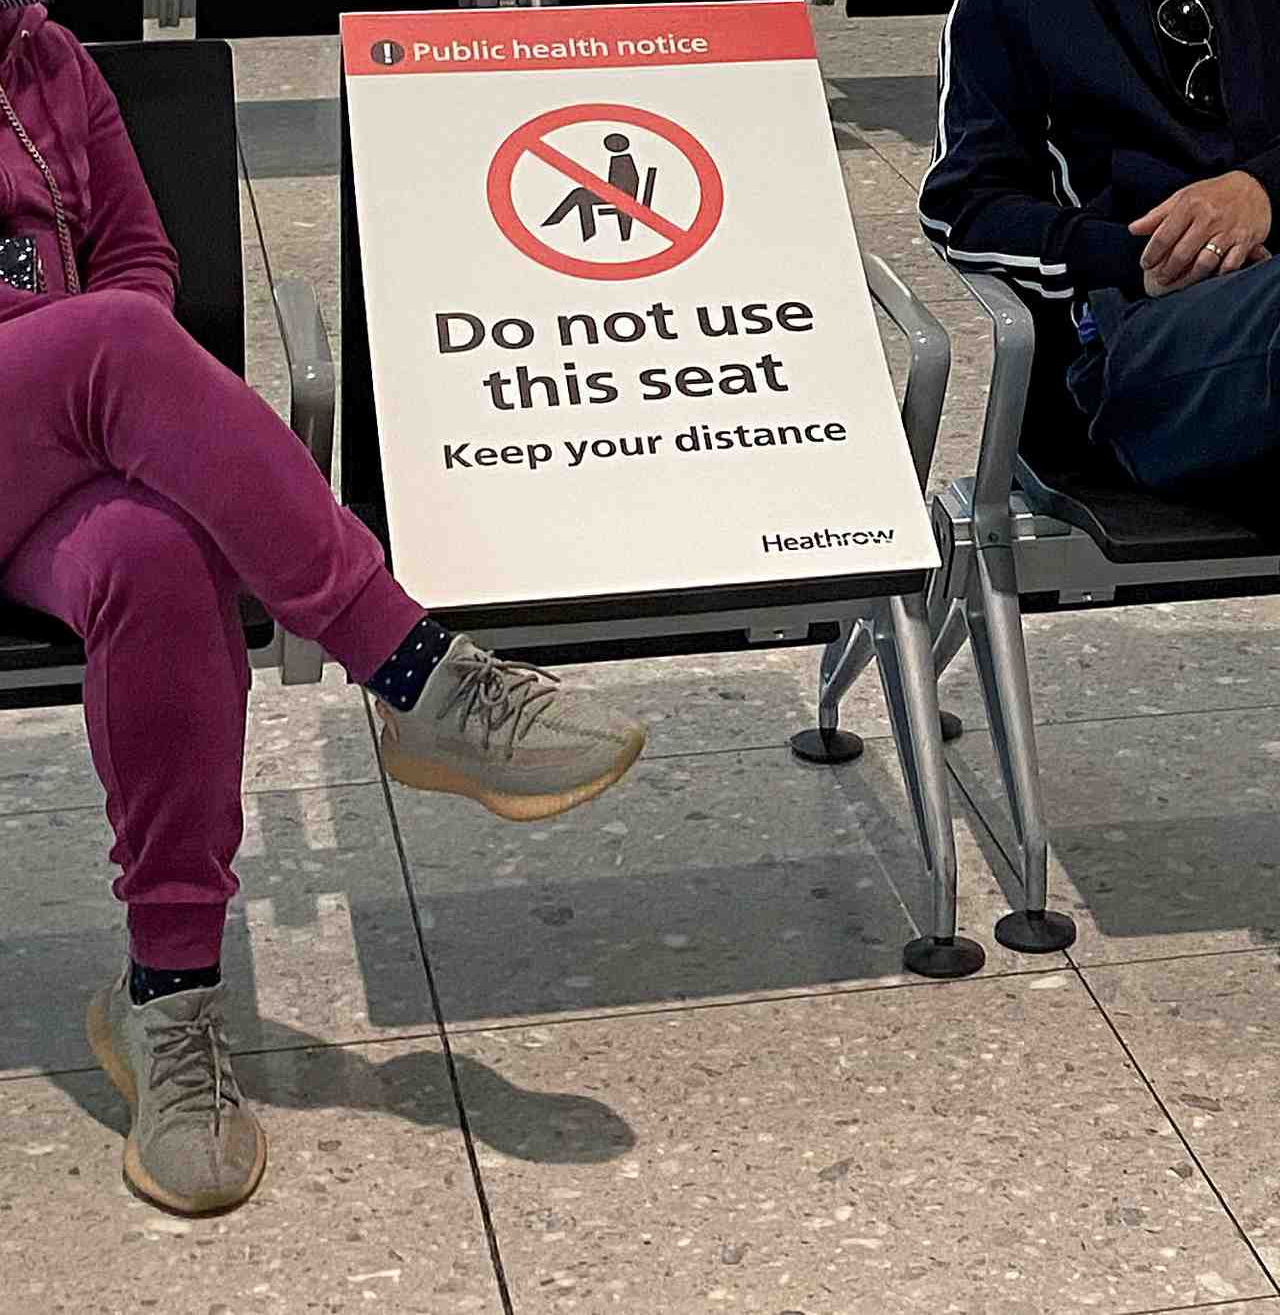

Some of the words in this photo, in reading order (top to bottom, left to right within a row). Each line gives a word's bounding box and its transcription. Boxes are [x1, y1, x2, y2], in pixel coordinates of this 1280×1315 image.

[412, 39, 506, 62] Public
[512, 37, 609, 59] health
[616, 33, 708, 56] notice
[435, 312, 535, 355] Do
[557, 301, 679, 347] not
[695, 301, 814, 338] use
[482, 361, 619, 411] this
[638, 353, 789, 401] seat
[443, 442, 553, 471] Keep
[563, 434, 663, 468] your
[674, 422, 847, 453] distance
[761, 528, 894, 553] Heathrow
